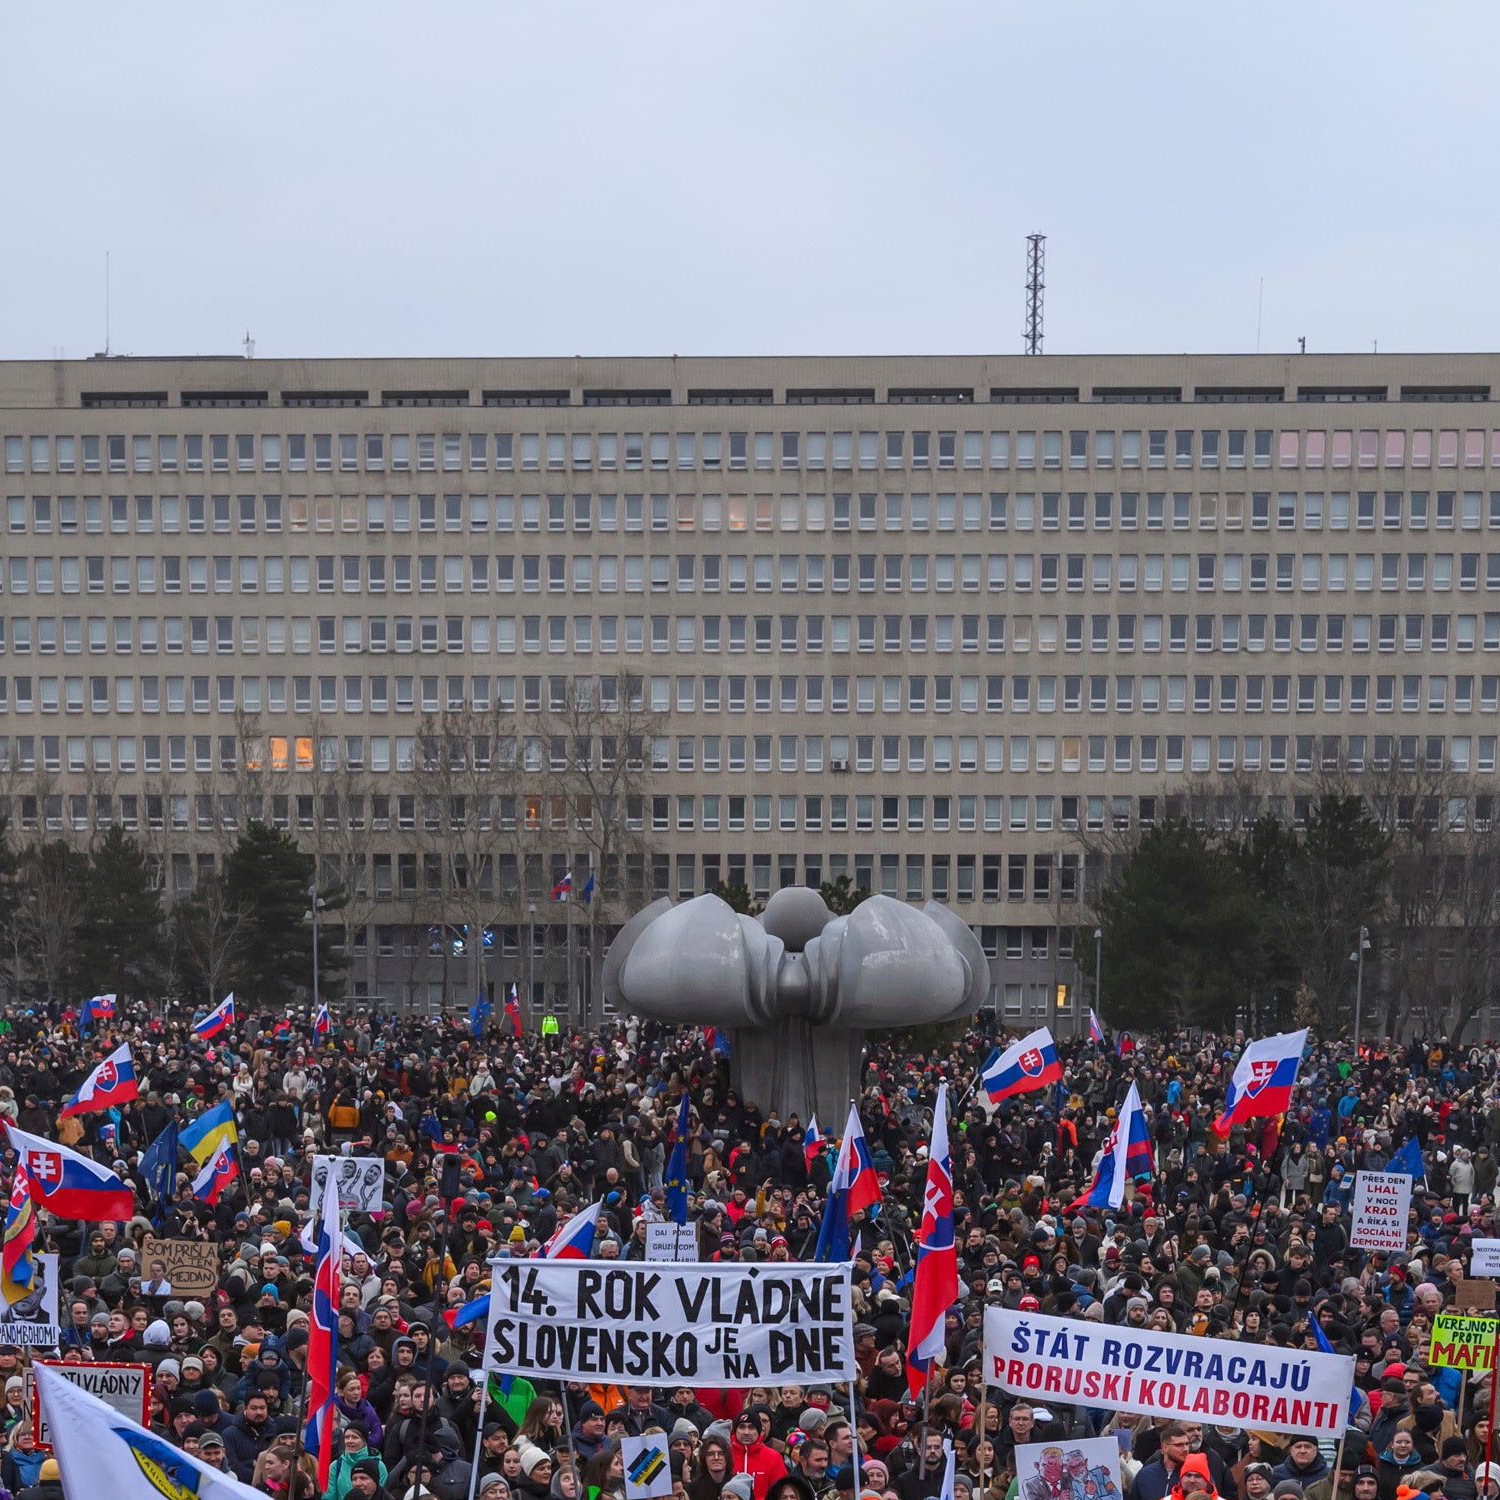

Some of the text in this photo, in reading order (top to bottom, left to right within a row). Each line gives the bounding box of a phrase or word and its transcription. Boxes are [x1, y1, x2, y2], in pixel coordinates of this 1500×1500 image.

[1363, 1174, 1406, 1185] PŘES DEN
[1367, 1184, 1399, 1195] LHAL
[1375, 1198, 1397, 1206] NOCI
[1364, 1205, 1398, 1216] KRAD
[146, 1240, 216, 1258] SOM PRIŠLA
[1352, 1237, 1404, 1249] DEMOKRAT
[166, 1256, 212, 1267] NA TEN
[501, 1265, 845, 1325] 14. ROK VLÁDNE
[1451, 1332, 1483, 1345] PROTI
[492, 1318, 845, 1378] SLOVENSKO JE DNE
[1010, 1320, 1312, 1393] ŠTÁT ROZVRACAJÚ
[722, 1354, 761, 1380] NA
[993, 1355, 1339, 1430] PRORUSKÍ KOLABORANTI
